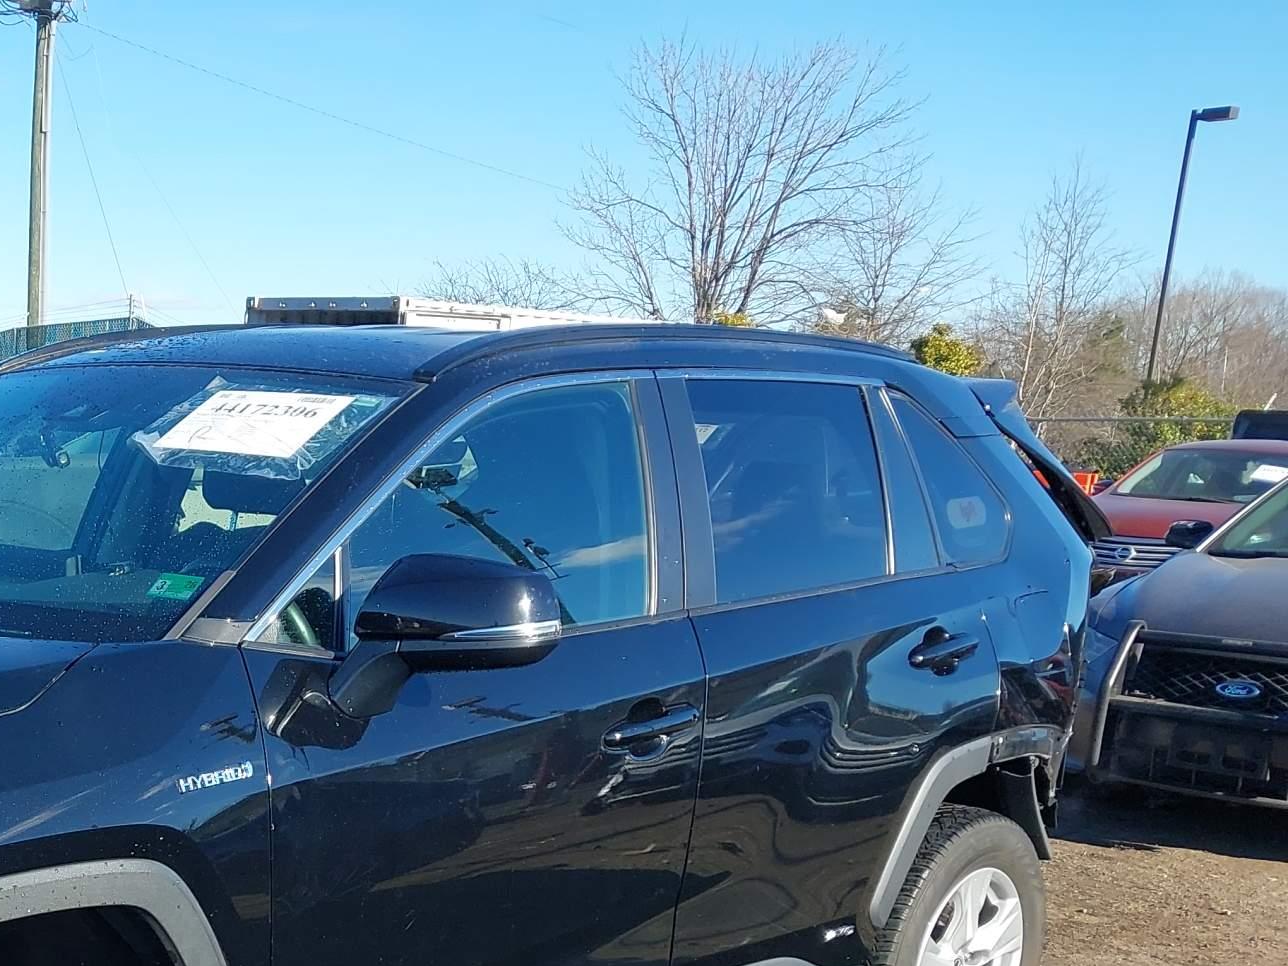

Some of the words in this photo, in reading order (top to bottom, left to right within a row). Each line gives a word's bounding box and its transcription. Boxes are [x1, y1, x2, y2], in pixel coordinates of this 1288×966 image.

[211, 402, 320, 418] 44172306
[155, 580, 167, 591] 3
[177, 766, 242, 793] HYBRID
